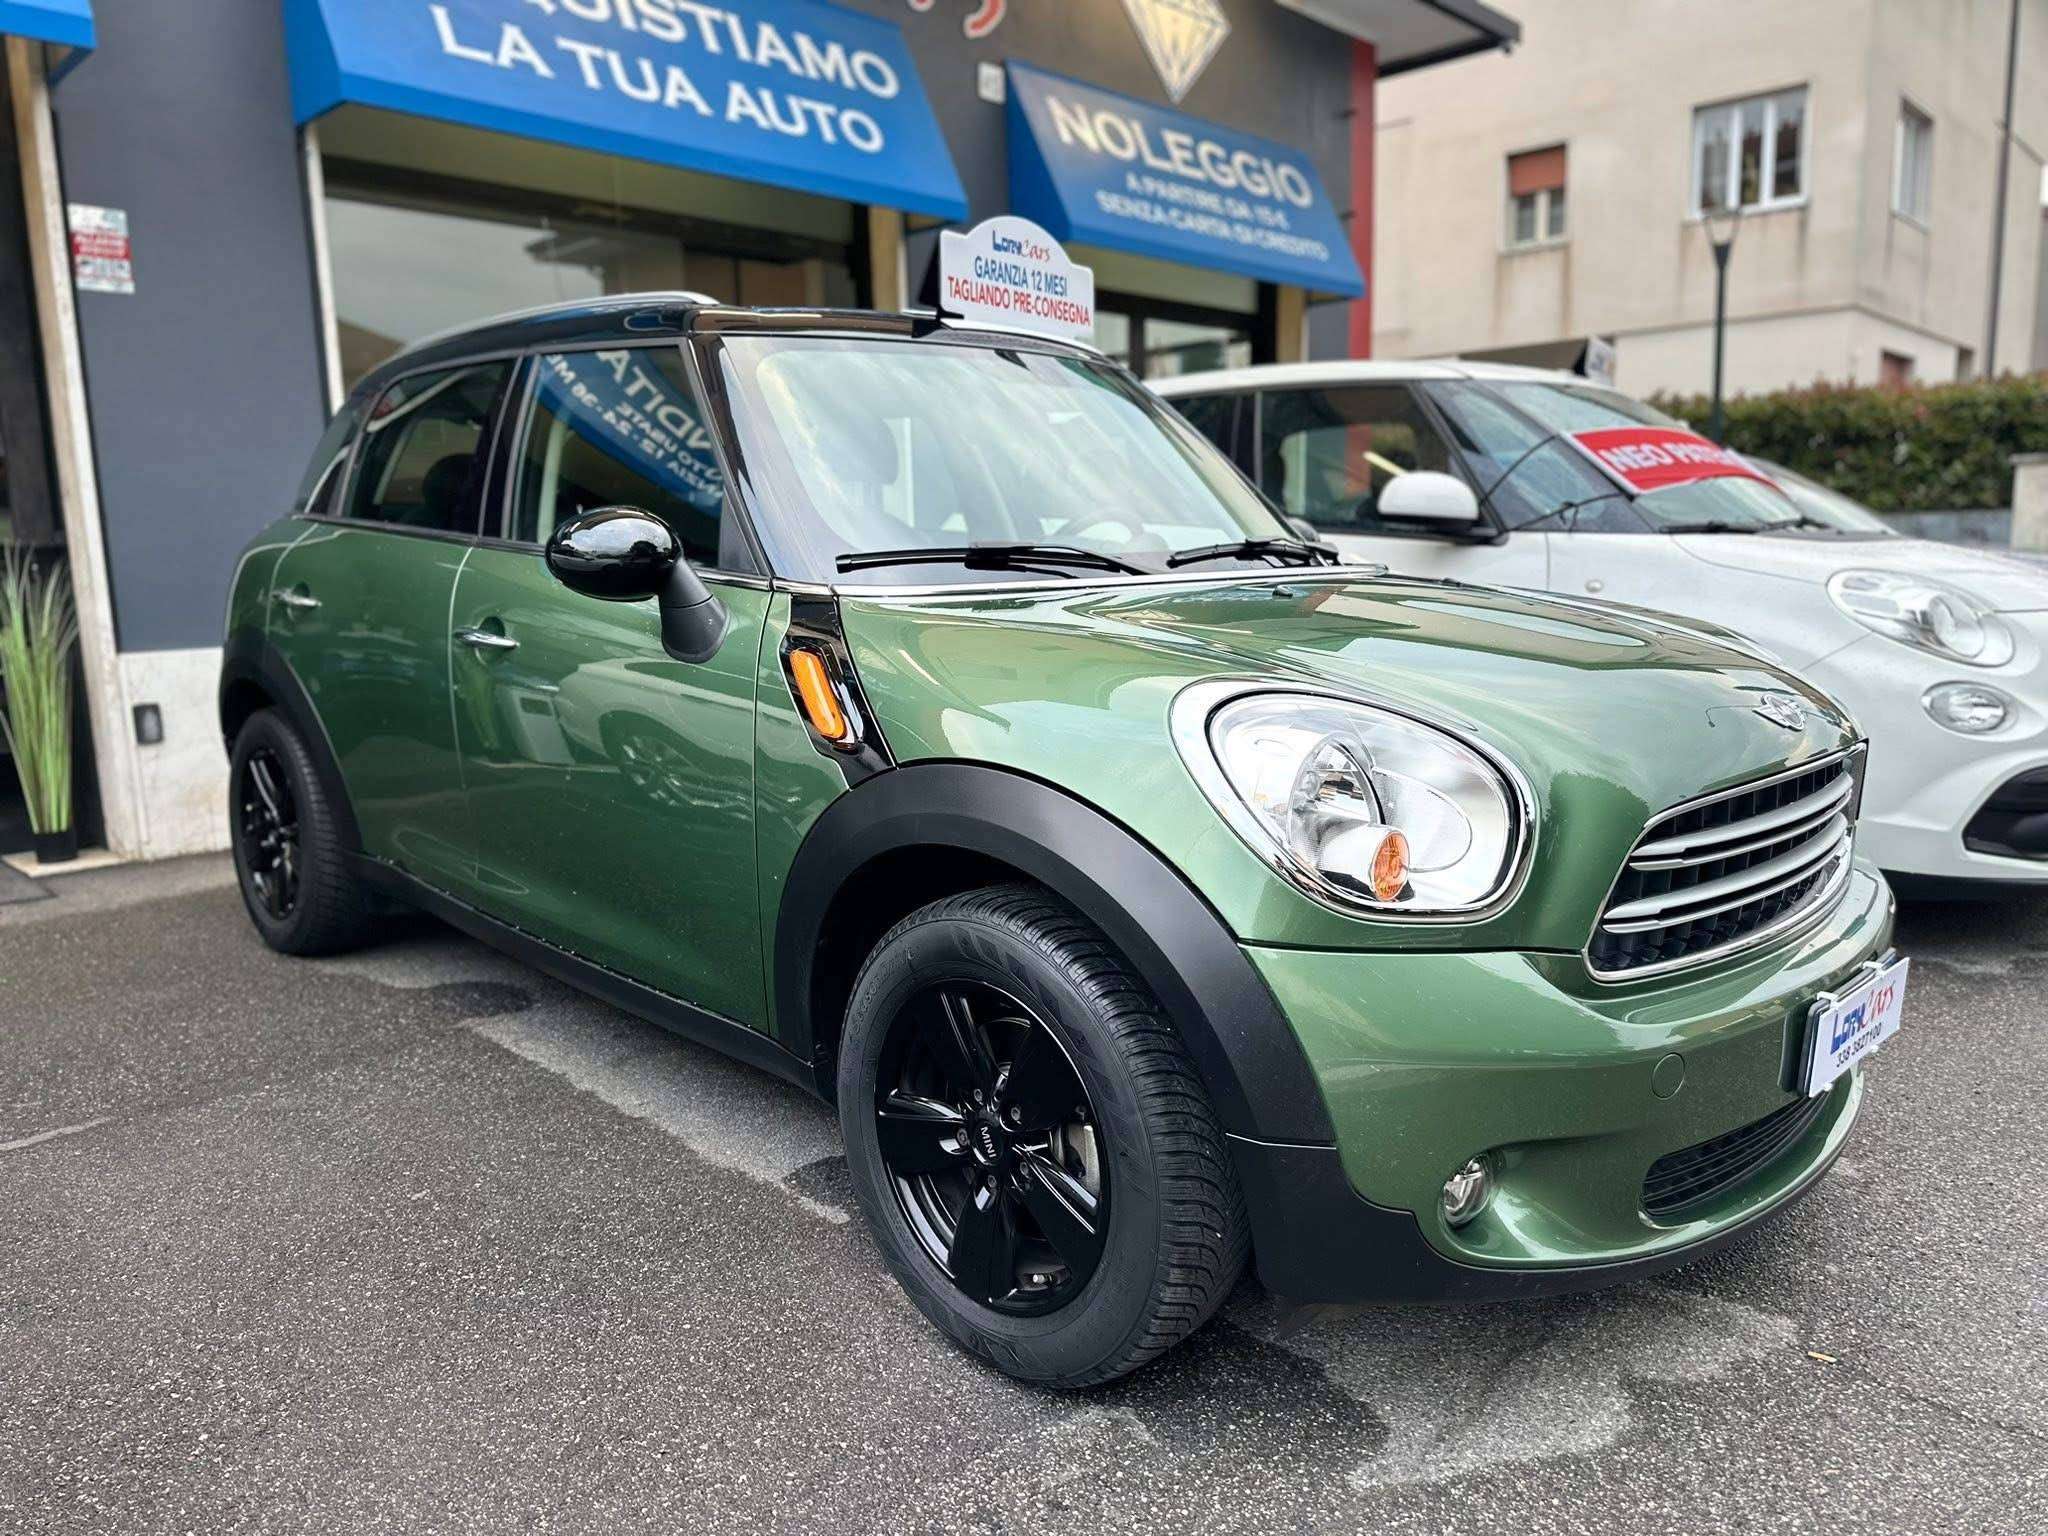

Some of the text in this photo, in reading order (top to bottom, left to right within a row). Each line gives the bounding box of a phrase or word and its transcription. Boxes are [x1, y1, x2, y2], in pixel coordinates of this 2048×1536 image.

[525, 0, 900, 99] ISTIAMO
[431, 4, 884, 154] LA TUA AUTO
[1045, 94, 1313, 208] NOLEGGIO
[1168, 207, 1231, 239] CARTA
[948, 276, 1091, 326] TAGLIANDO PRE-CONSEGNA
[974, 256, 1067, 297] GARANZIA 12 MESI
[981, 1126, 997, 1158] MINI
